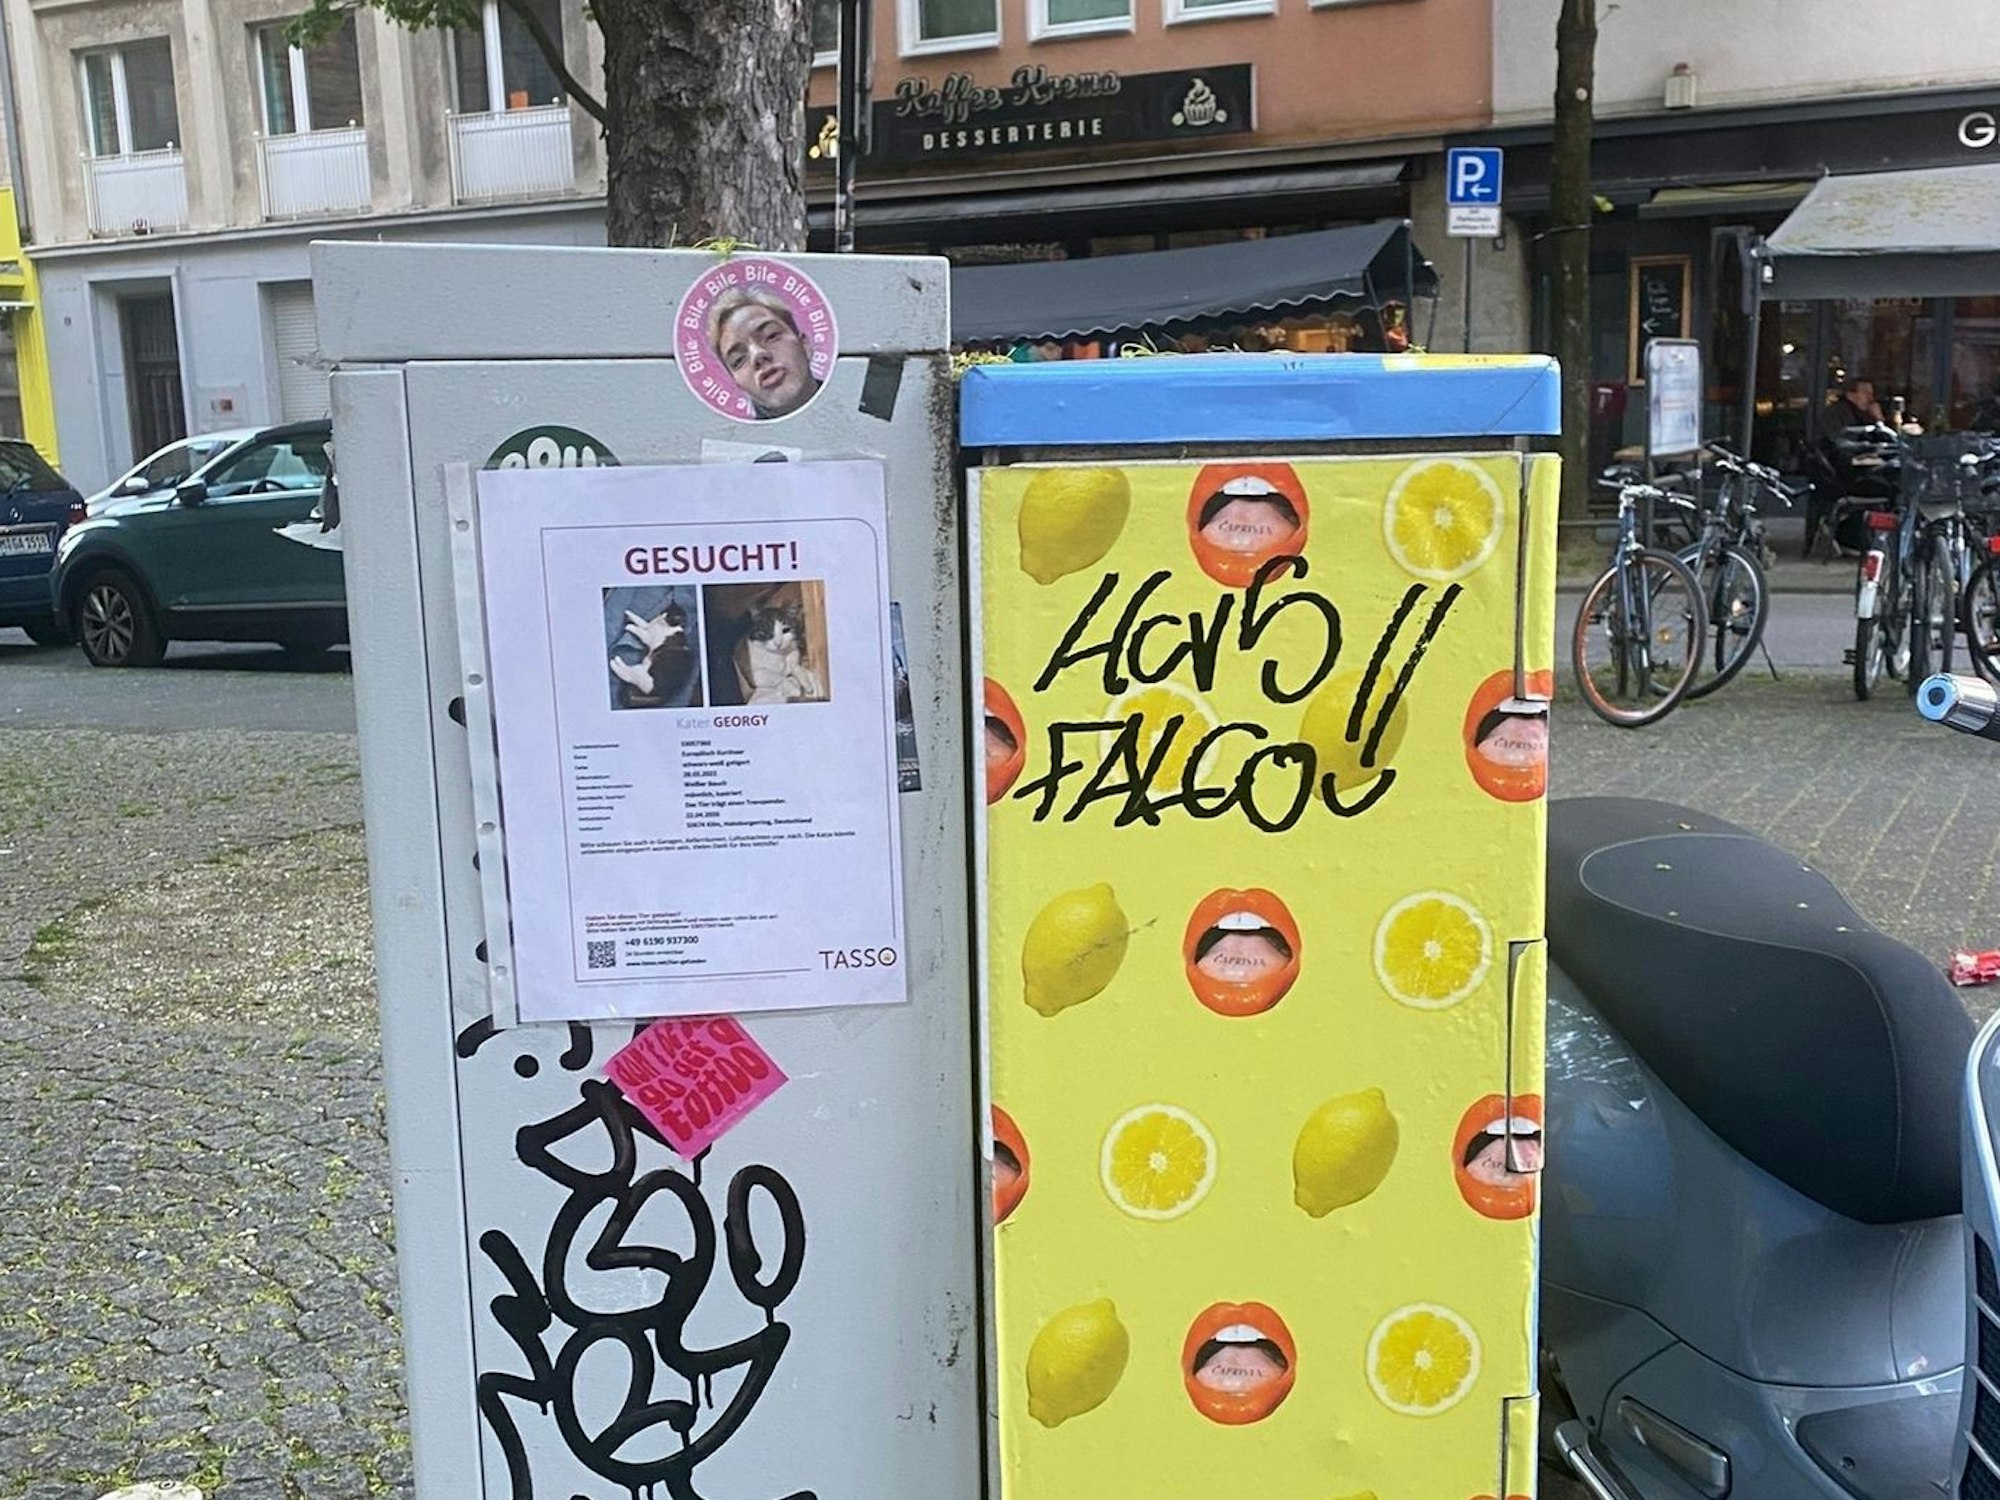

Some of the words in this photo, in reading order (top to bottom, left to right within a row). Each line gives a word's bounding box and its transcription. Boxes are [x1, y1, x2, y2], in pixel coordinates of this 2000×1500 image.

[896, 73, 1003, 123] Kaffee
[1011, 64, 1121, 106] Krema
[923, 118, 1102, 150] DESSERTERIE
[1958, 111, 2000, 148] G
[1456, 155, 1486, 197] P
[705, 273, 738, 297] Bile
[745, 265, 778, 284] Bile
[783, 276, 811, 307] Bile
[683, 298, 708, 329] Bile
[808, 310, 830, 343] Bile
[684, 340, 705, 374] Bile
[702, 376, 731, 406] Bile
[624, 541, 799, 576] GESUCHT!
[677, 718, 709, 729] Kater
[713, 715, 769, 728] GEORGY
[625, 937, 641, 947] +49
[643, 936, 664, 946] 6190
[666, 935, 699, 945] 937300
[819, 947, 897, 969] TASSO
